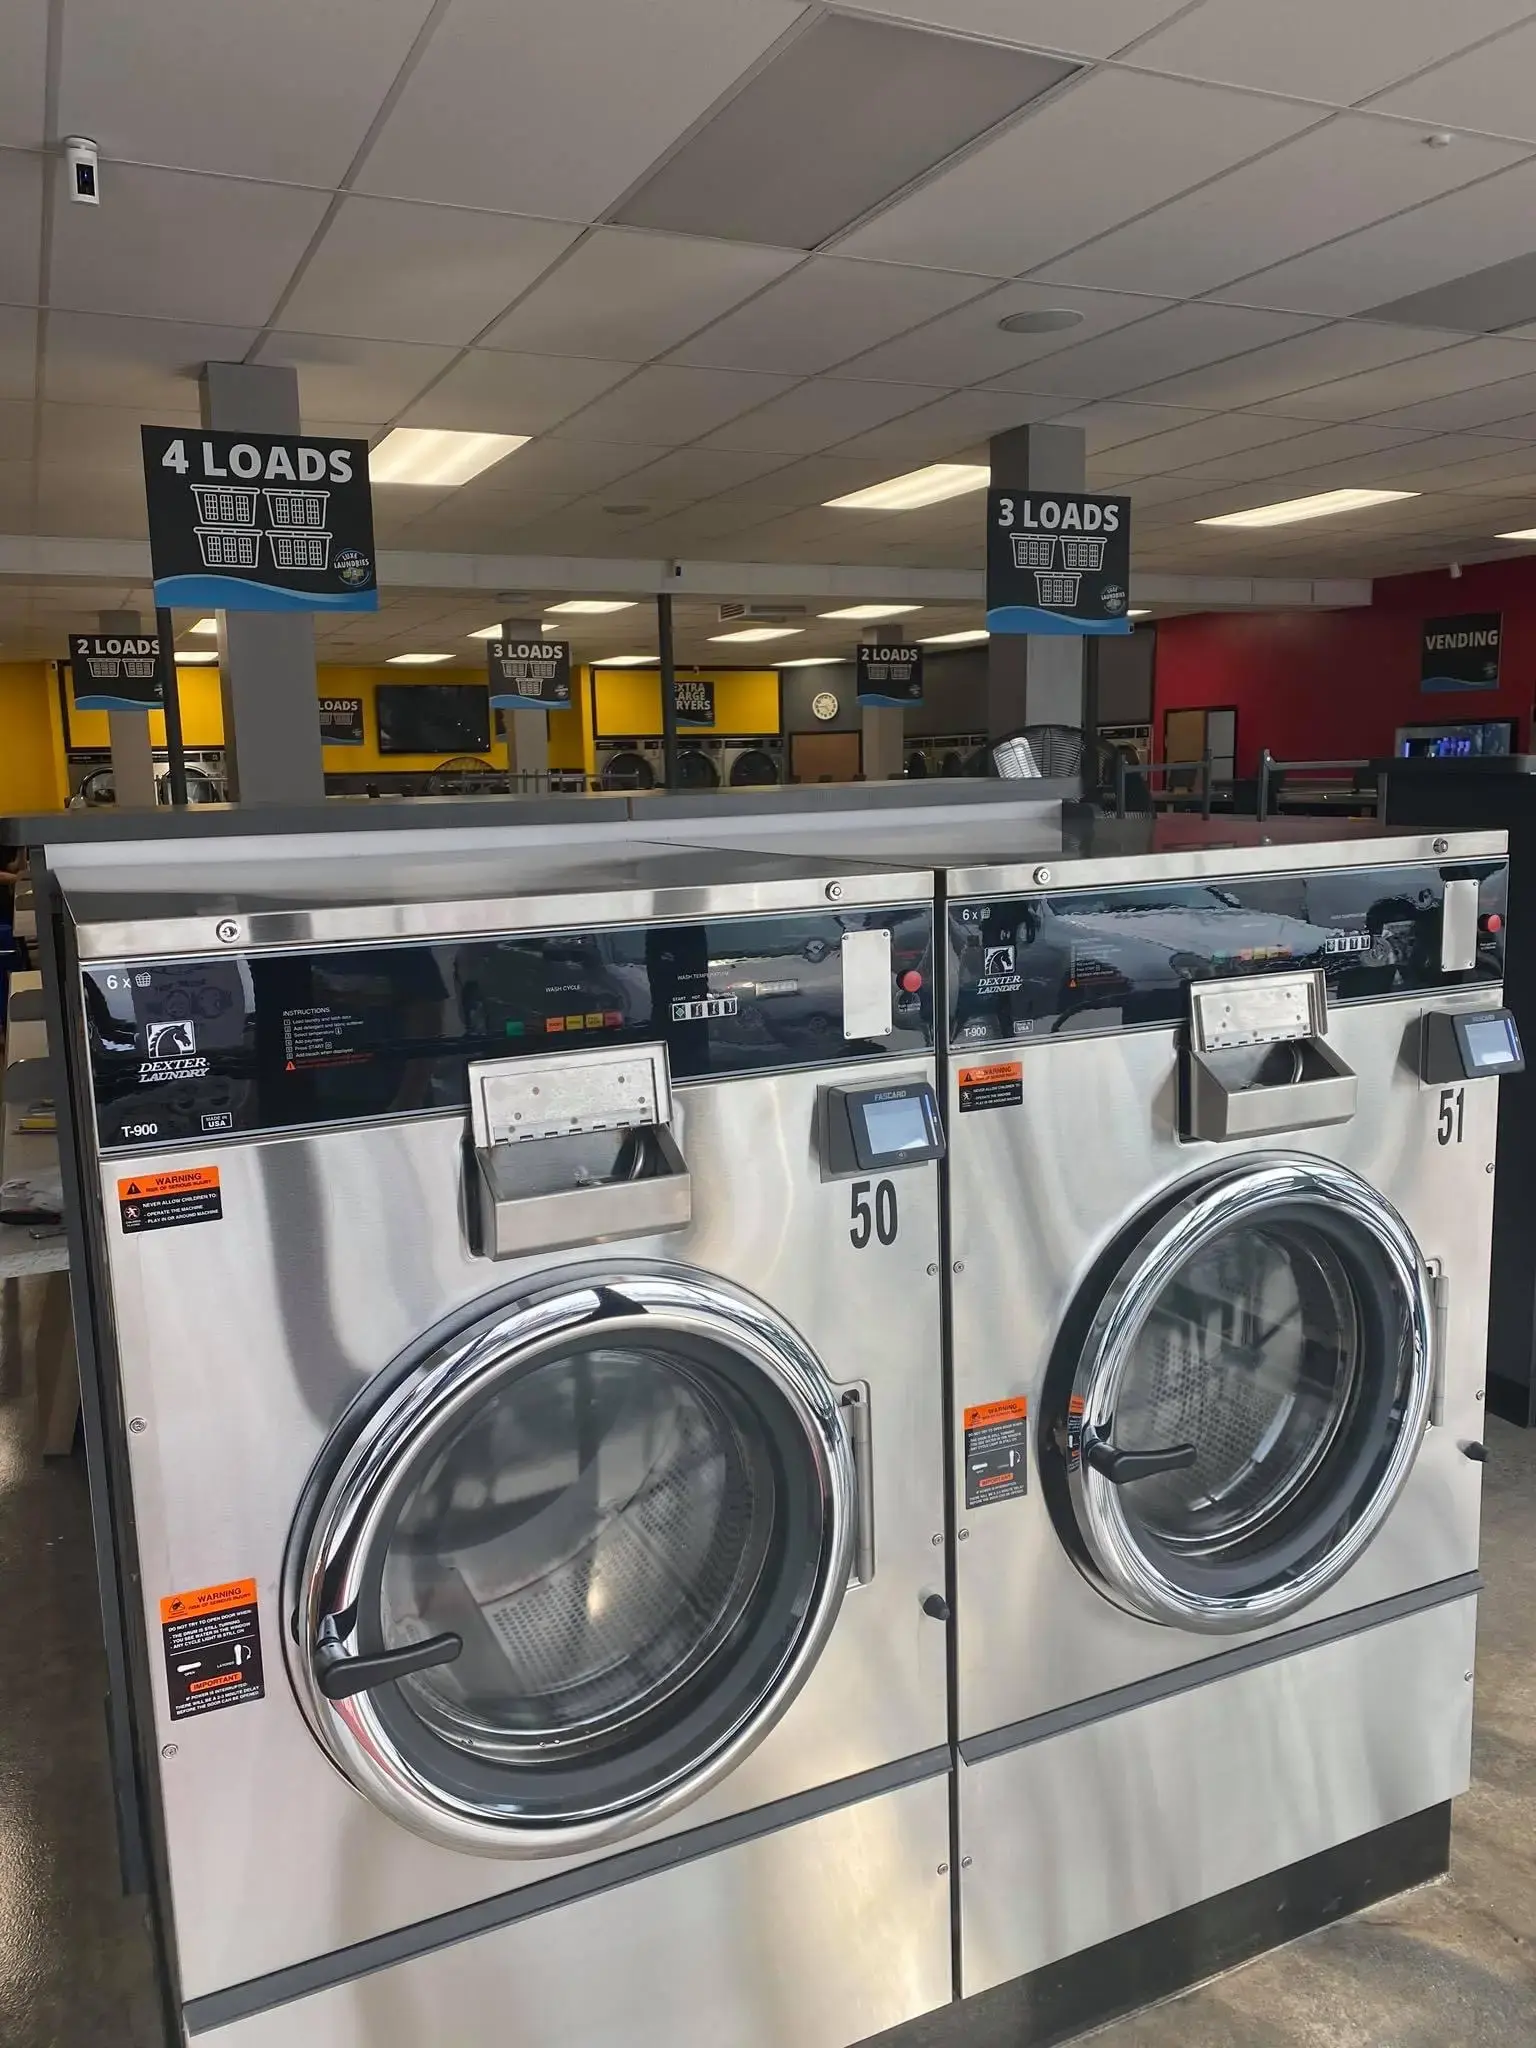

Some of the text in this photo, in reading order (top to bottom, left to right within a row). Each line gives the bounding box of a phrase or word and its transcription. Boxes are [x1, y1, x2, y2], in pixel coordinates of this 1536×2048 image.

[162, 439, 353, 483] 4 LOADS
[998, 498, 1119, 532] 3 LOADS
[334, 558, 370, 568] LAUNDRIES
[77, 638, 160, 655] 2 LOADS
[1426, 630, 1498, 650] VENDING
[494, 644, 564, 659] 3 LOADS
[862, 648, 918, 662] 2 LOADS
[318, 700, 358, 711] LOADS
[676, 700, 710, 710] RYERS
[962, 908, 978, 920] 6 x
[106, 974, 132, 989] 6 x
[978, 976, 1020, 986] DEXTER
[977, 983, 1022, 994] LAUNDRY
[283, 1006, 330, 1016] INSTRUCTIONS
[964, 1026, 986, 1037] T-900
[138, 1057, 206, 1074] DEXTER
[138, 1068, 210, 1084] LAUNDRY
[874, 1090, 906, 1101] FASCARD
[208, 1120, 226, 1128] USA
[1438, 1088, 1464, 1146] 51
[121, 1123, 158, 1138] T-900
[156, 1173, 202, 1185] WARNING
[850, 1179, 898, 1250] 50
[198, 1588, 242, 1602] WARNING
[193, 1674, 240, 1690] IMPORTANT
